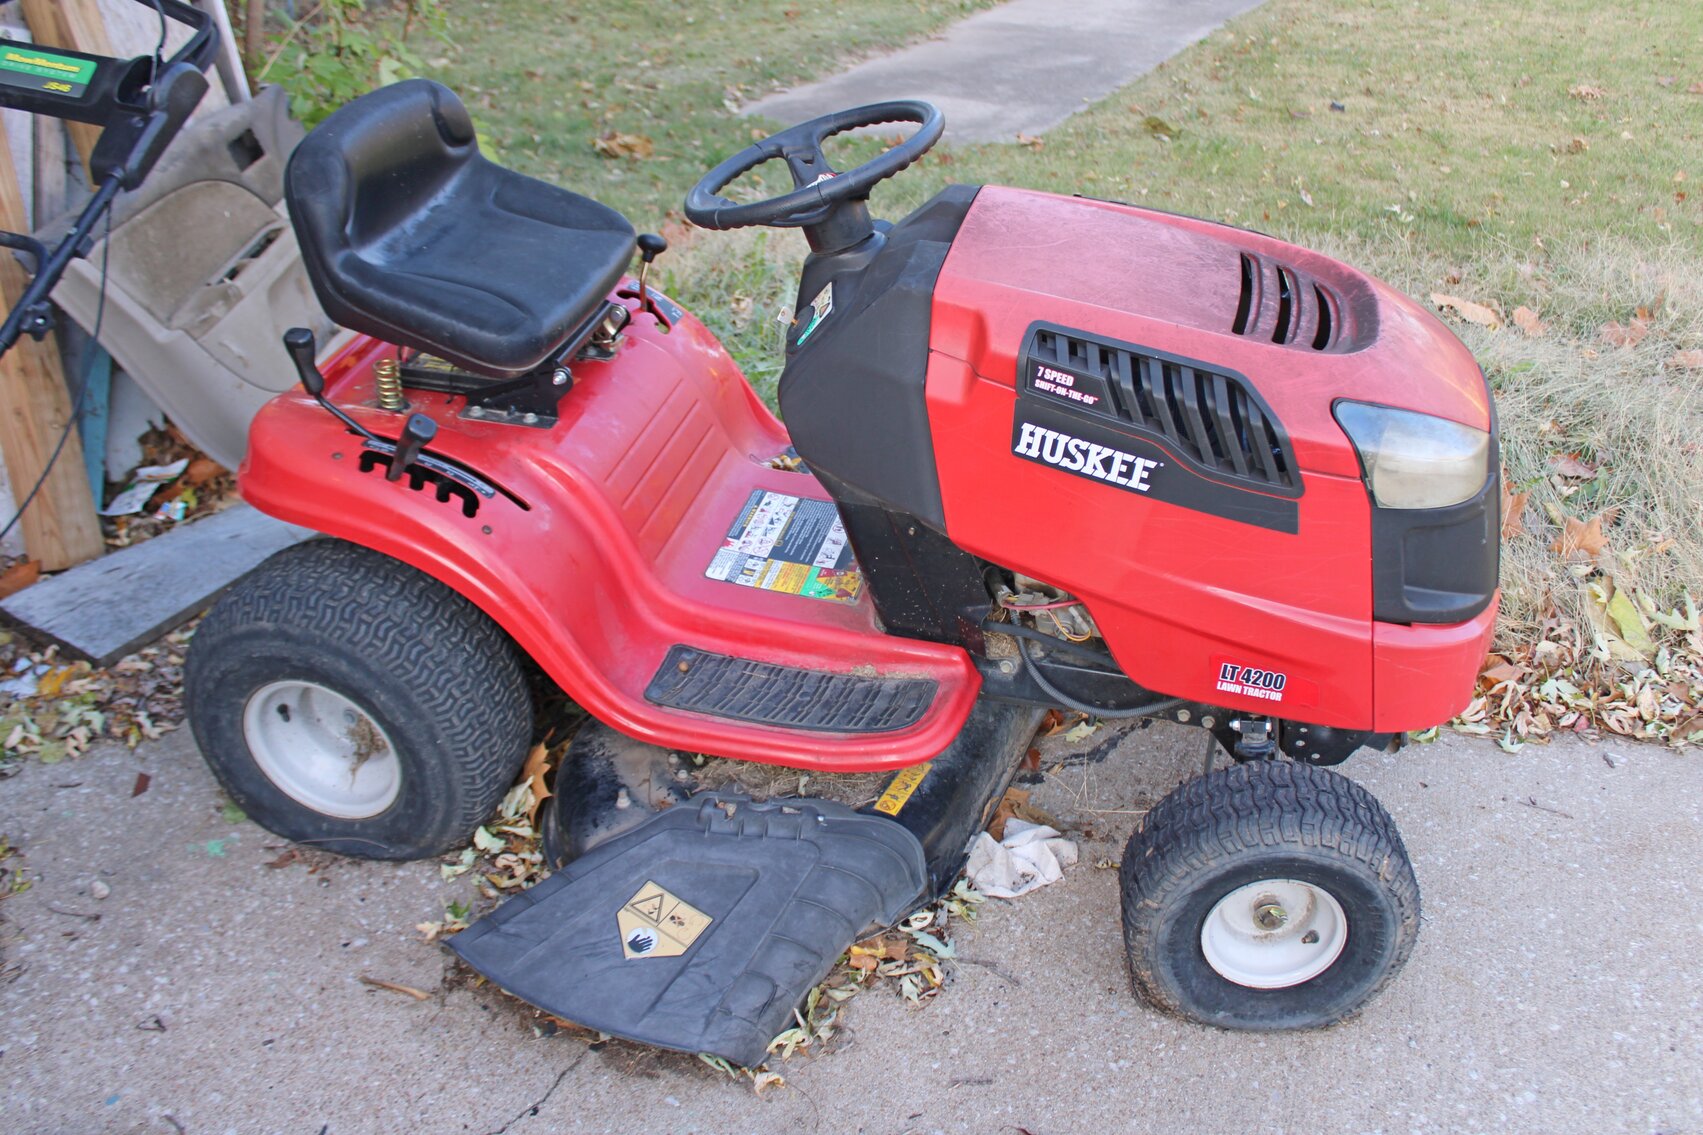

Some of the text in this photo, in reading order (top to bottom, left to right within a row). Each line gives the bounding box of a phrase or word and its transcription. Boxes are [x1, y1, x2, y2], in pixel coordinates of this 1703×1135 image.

[1037, 366, 1074, 387] 7 SPEED
[1014, 422, 1158, 492] HUSKEE
[1219, 663, 1287, 691] LT 4200
[1216, 681, 1283, 702] LAWN TRACTOR
